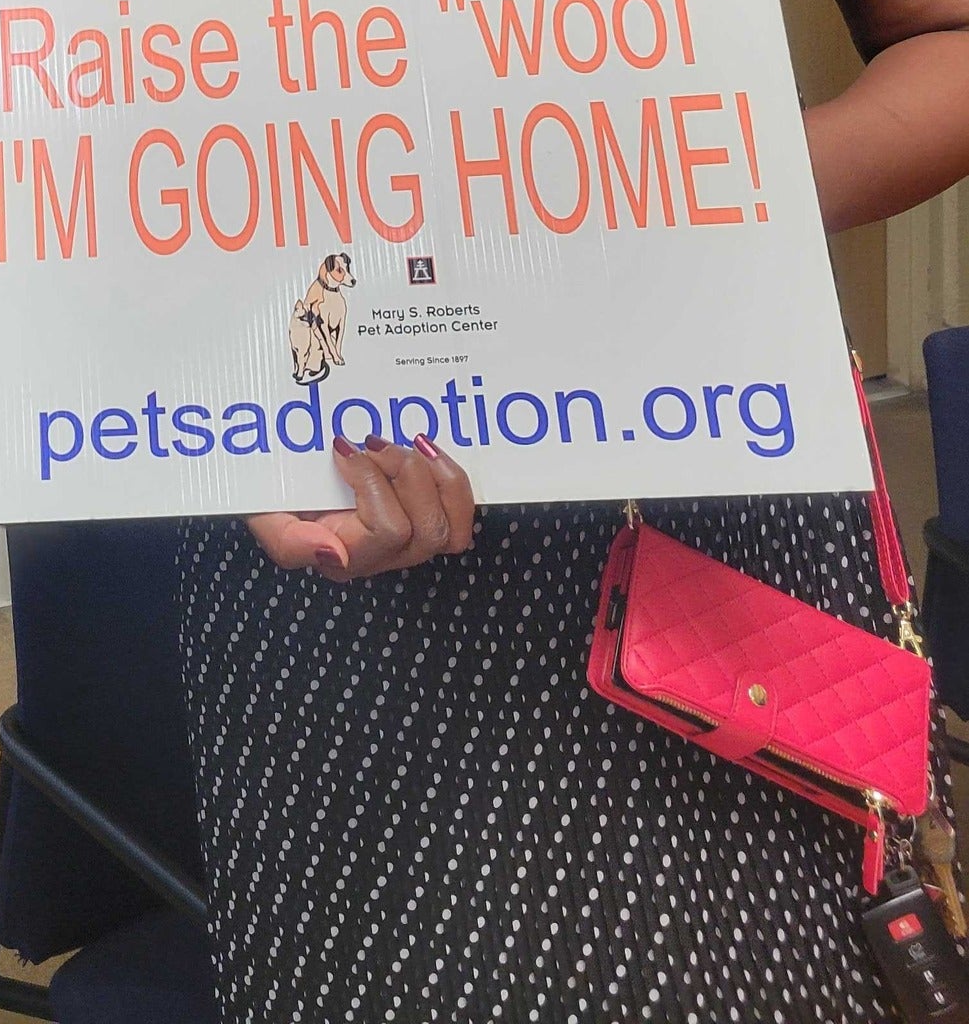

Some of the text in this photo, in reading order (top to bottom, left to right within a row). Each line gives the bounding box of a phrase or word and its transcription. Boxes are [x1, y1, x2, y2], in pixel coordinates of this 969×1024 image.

[0, 1, 240, 112] Raise
[129, 114, 424, 256] GOING
[450, 92, 770, 238] HOME!
[357, 319, 498, 336] Pet Adoption Center
[372, 304, 481, 321] Mary S. Roberts
[395, 355, 469, 366] Serving Since 1897
[39, 376, 795, 481] petsadoption.org
